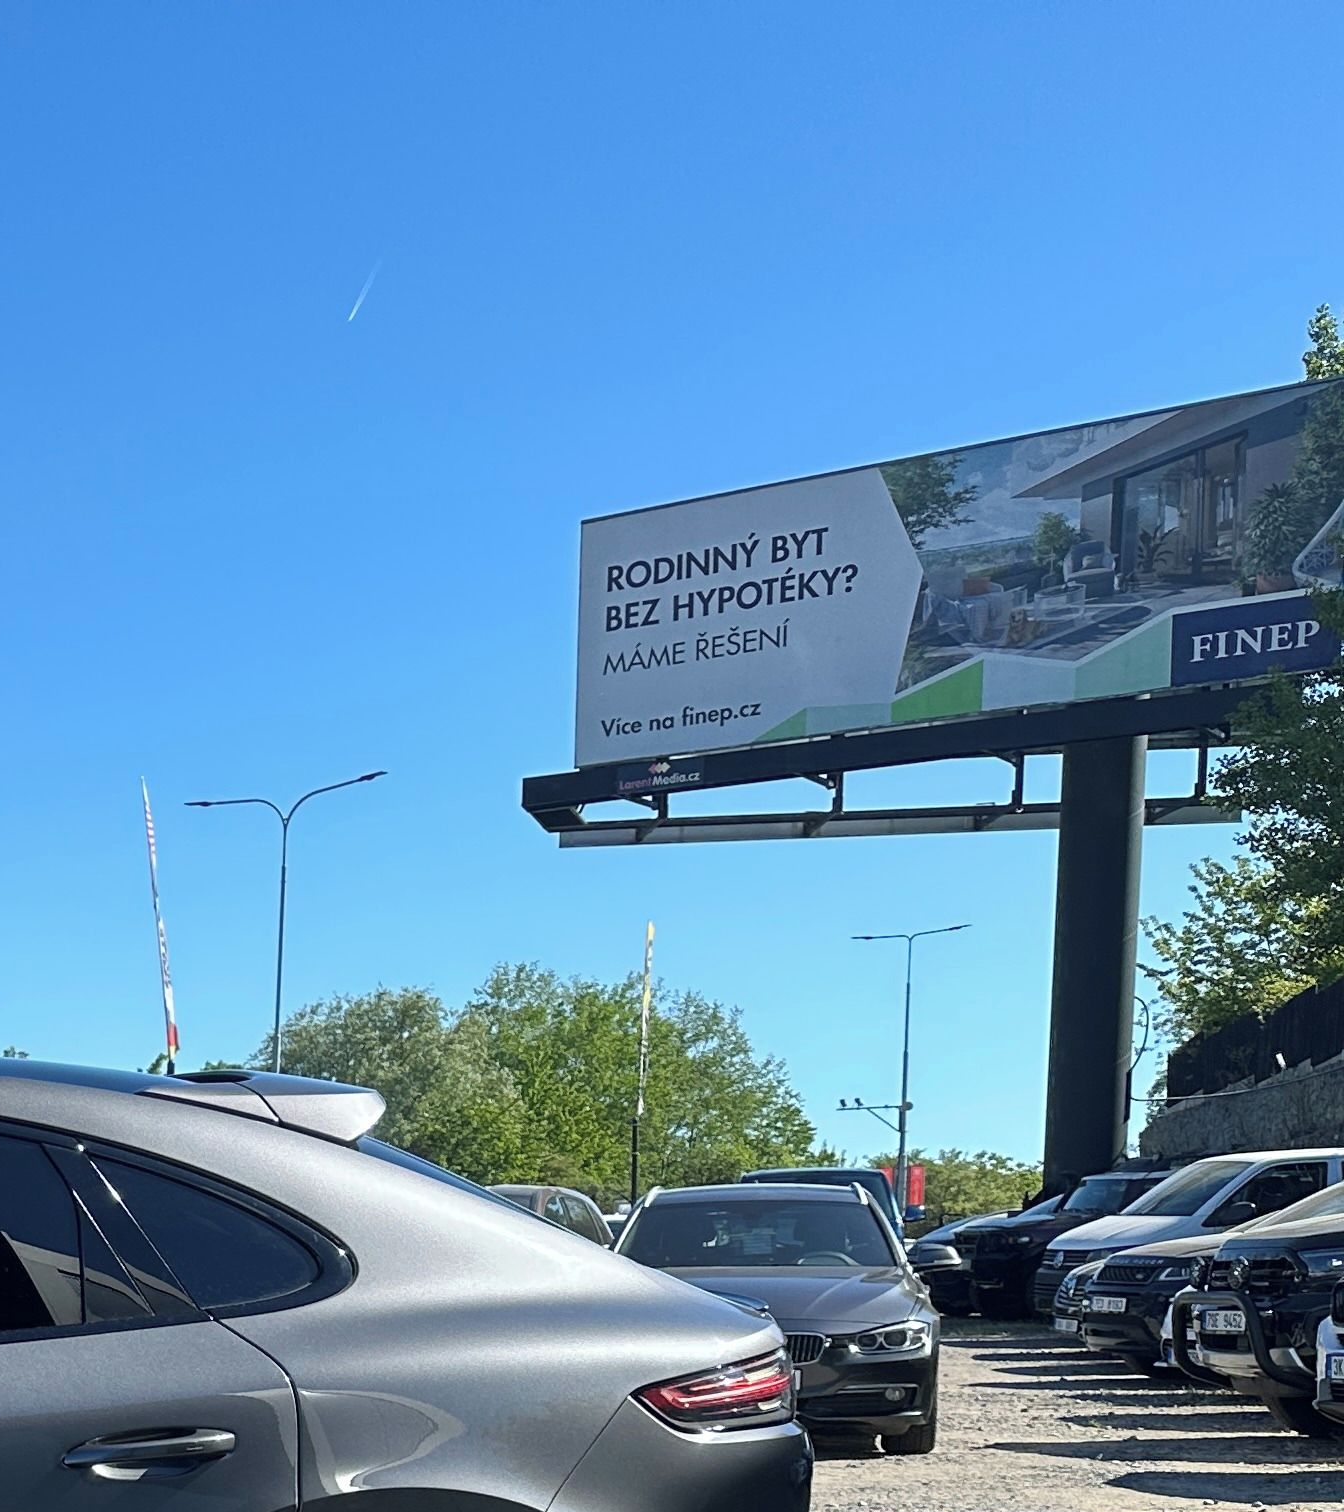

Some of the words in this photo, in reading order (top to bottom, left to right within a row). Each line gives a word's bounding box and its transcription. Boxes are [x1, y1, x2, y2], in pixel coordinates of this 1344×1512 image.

[606, 532, 760, 592] RODINNÝ
[771, 527, 829, 563] BYT
[605, 598, 660, 632] BEZ
[672, 563, 859, 621] HYPOTÉKY?
[602, 642, 686, 676] MÁME
[695, 618, 791, 661] ŘEŠENÍ
[1189, 620, 1321, 663] FINEP
[601, 718, 643, 738] Více
[649, 716, 674, 731] na
[682, 703, 761, 727] finep.cz
